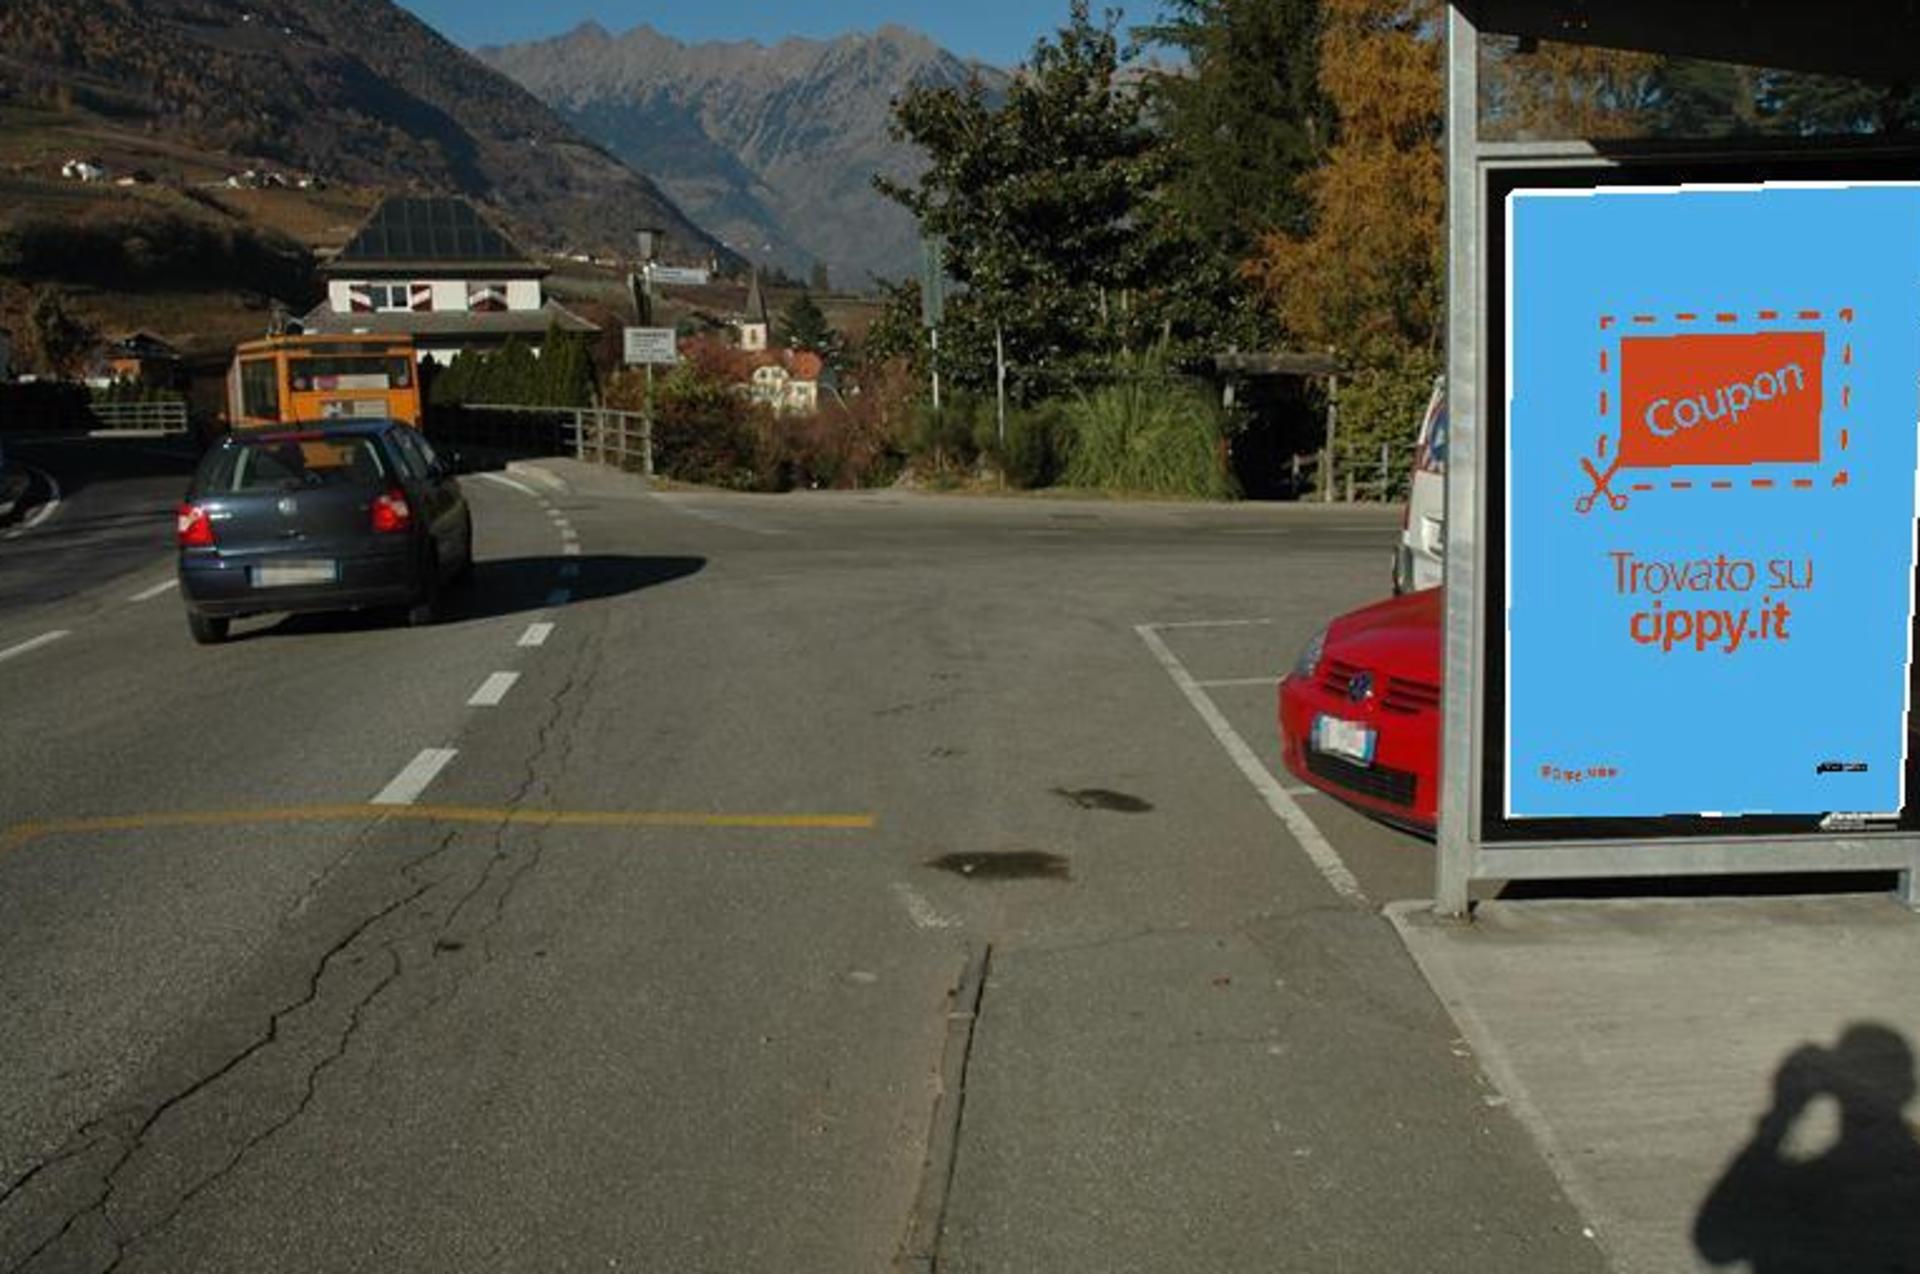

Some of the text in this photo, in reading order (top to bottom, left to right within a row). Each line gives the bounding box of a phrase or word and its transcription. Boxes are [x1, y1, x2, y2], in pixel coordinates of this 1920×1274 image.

[1645, 363, 1804, 438] Coupon
[1609, 551, 1813, 595] Trovato su
[1630, 596, 1791, 654] cippy.it
